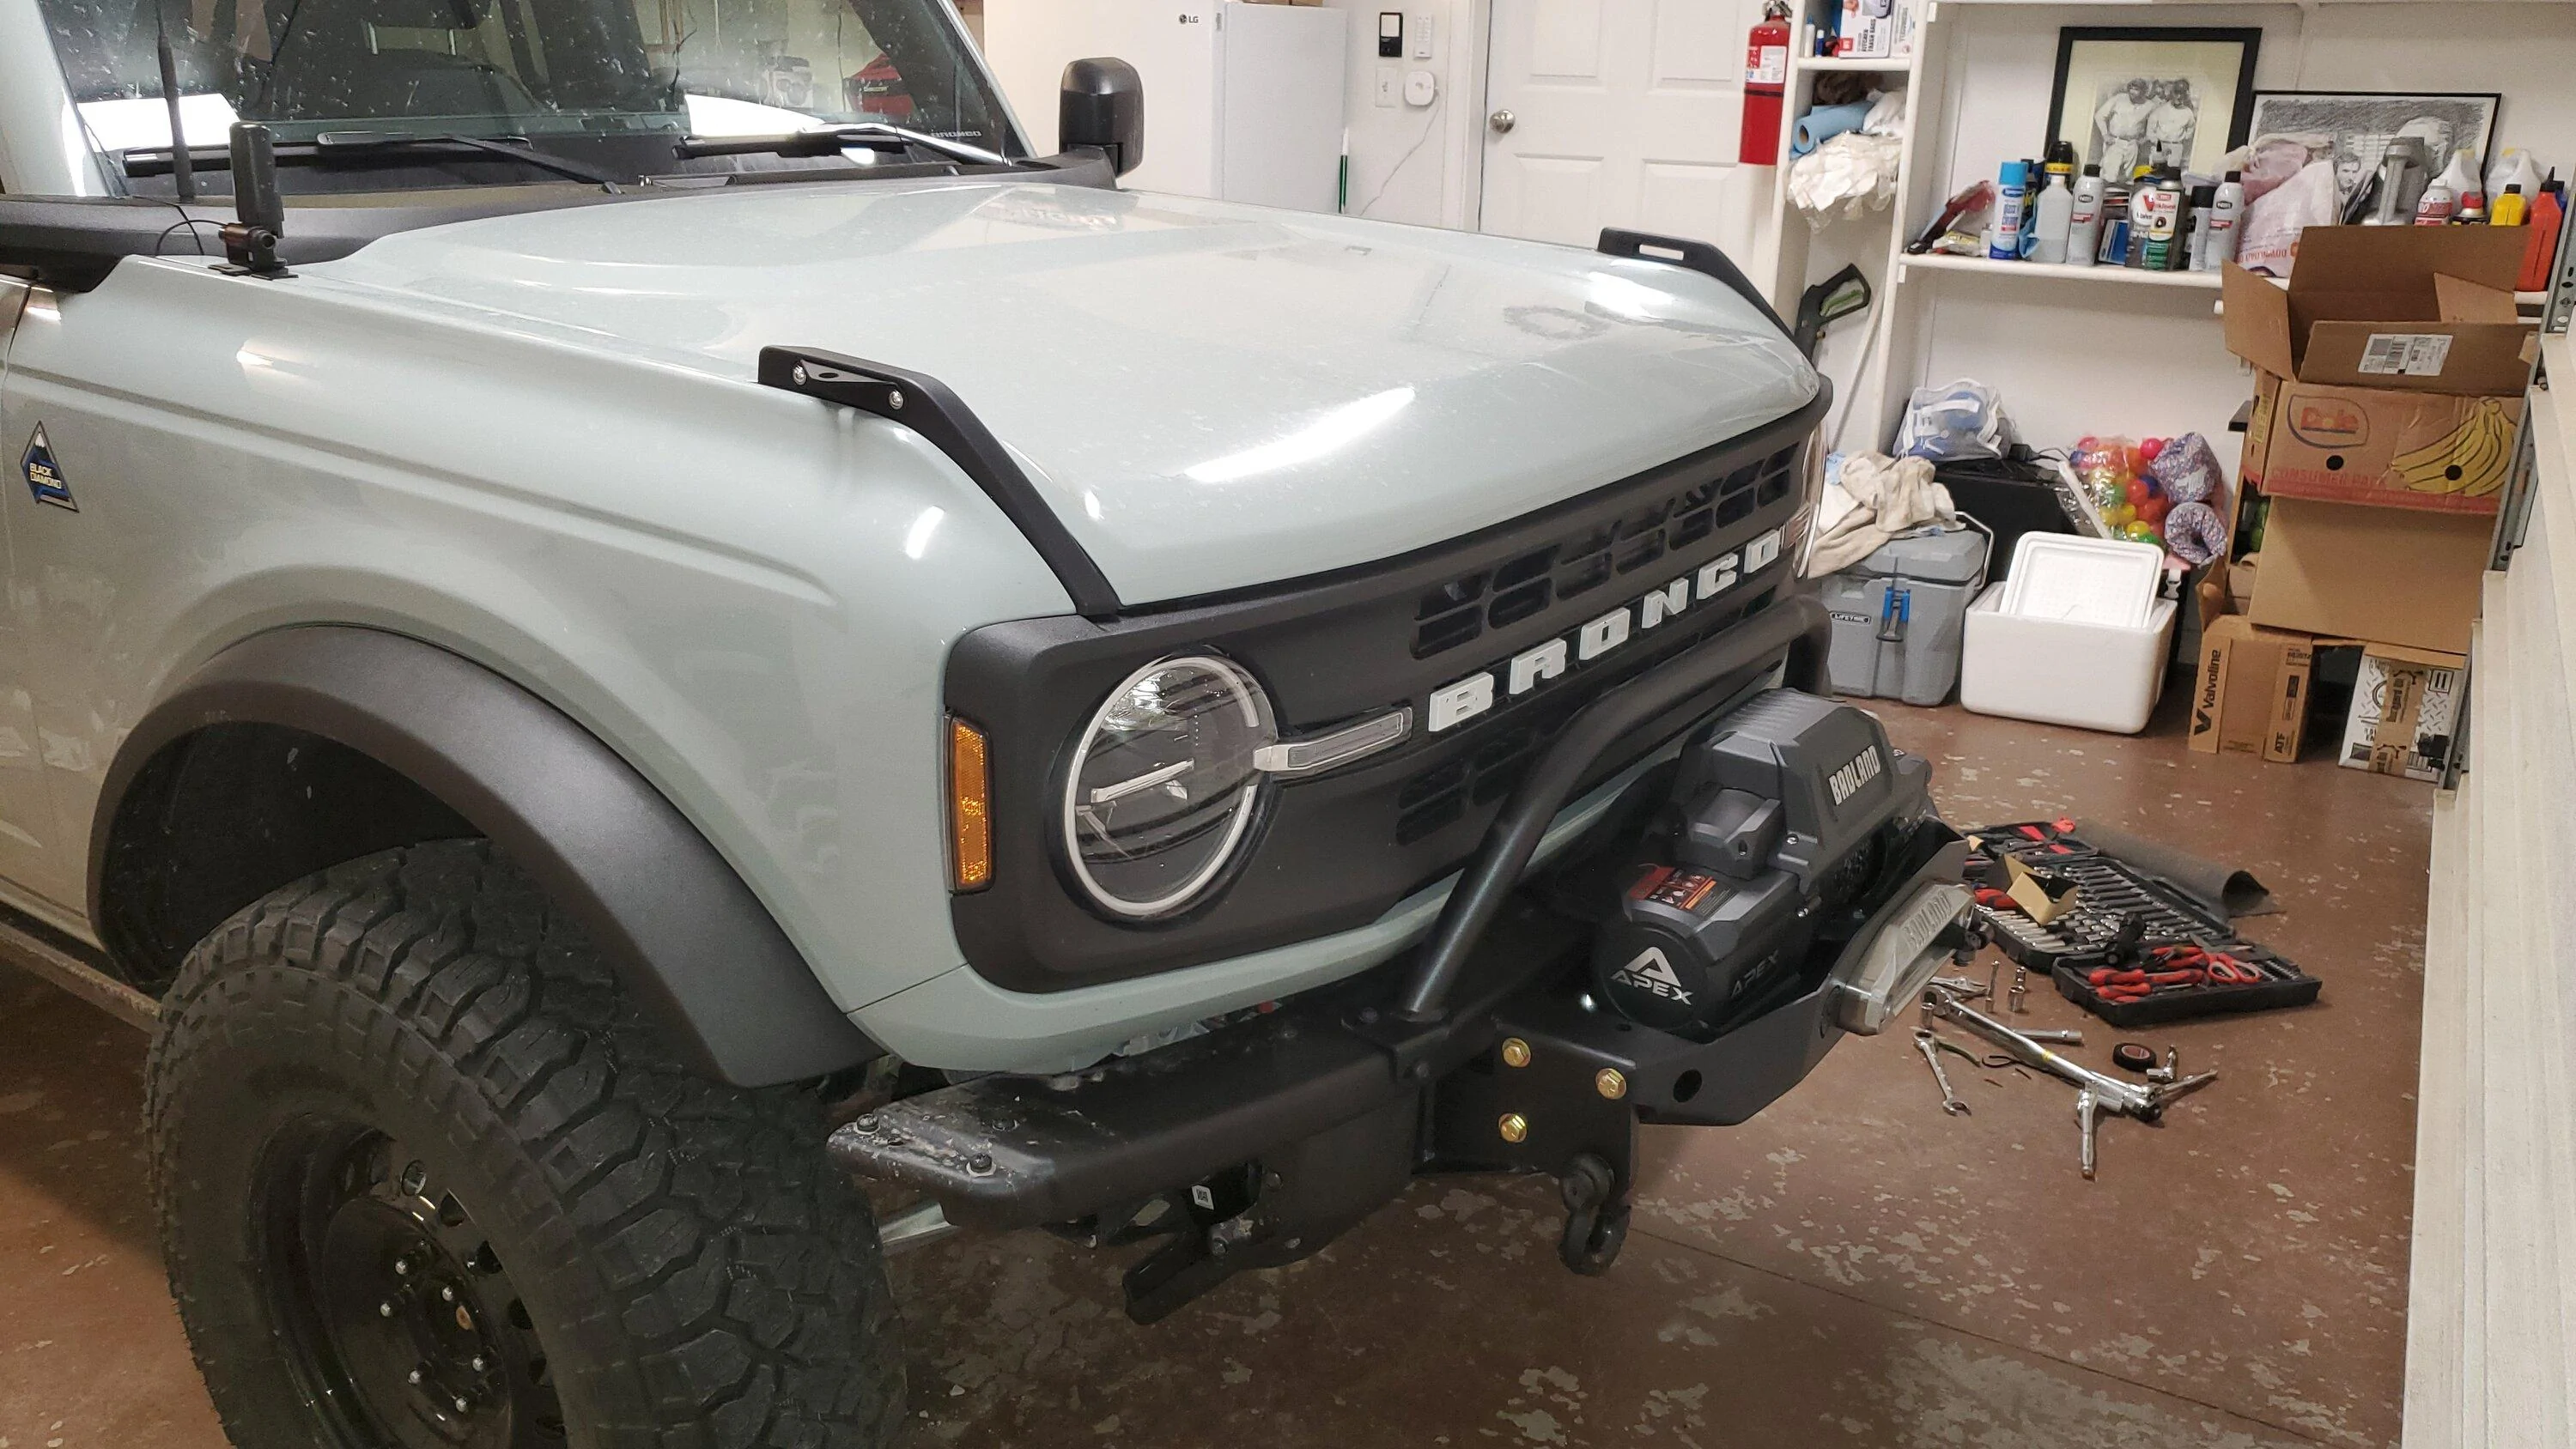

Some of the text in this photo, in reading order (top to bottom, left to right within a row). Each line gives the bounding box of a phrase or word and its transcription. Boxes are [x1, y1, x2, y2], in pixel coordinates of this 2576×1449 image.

[1188, 15, 1200, 24] LG
[29, 463, 52, 478] BLACK
[30, 471, 62, 489] DIAMOND
[1428, 529, 1780, 732] BRONCO
[2202, 649, 2221, 708] Valvoline
[2274, 731, 2286, 754] ATF
[1829, 745, 1881, 806] BADLAND
[1611, 970, 1693, 1005] APEX
